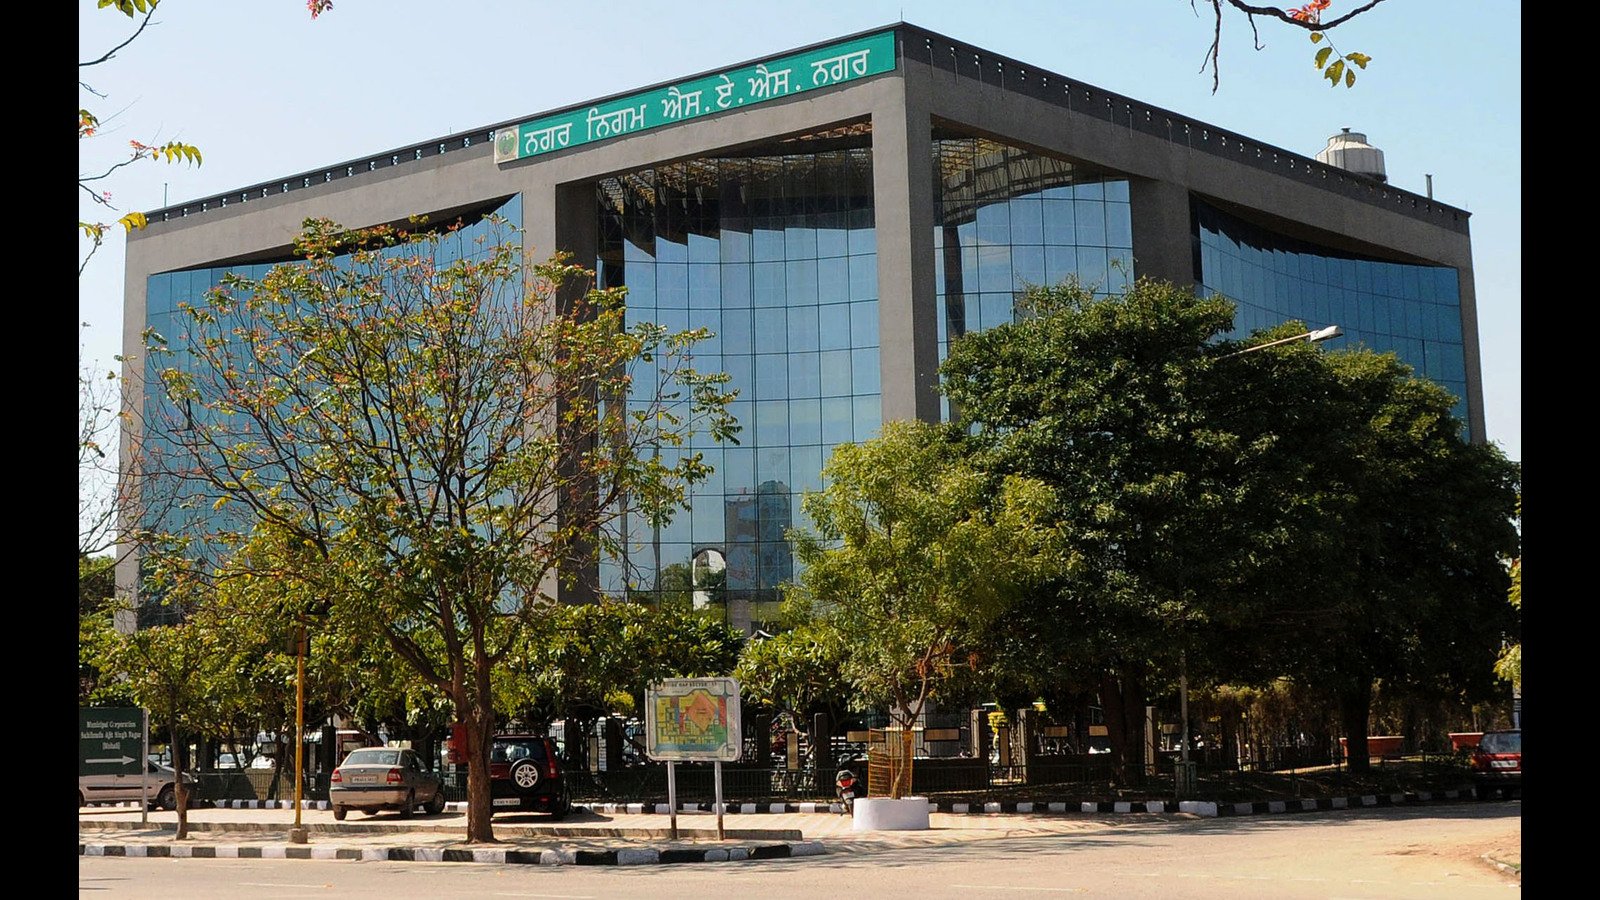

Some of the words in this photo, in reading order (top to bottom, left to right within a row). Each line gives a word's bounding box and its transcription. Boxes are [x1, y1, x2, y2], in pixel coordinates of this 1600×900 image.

[524, 122, 573, 154] ਨਗਰ
[586, 103, 647, 141] ਨਿਗਮ
[810, 49, 870, 85] ਨਗਰ
[87, 721, 108, 729] Municipal
[109, 721, 136, 729] Corporation
[114, 731, 127, 739] Singh
[128, 731, 142, 739] Nagar
